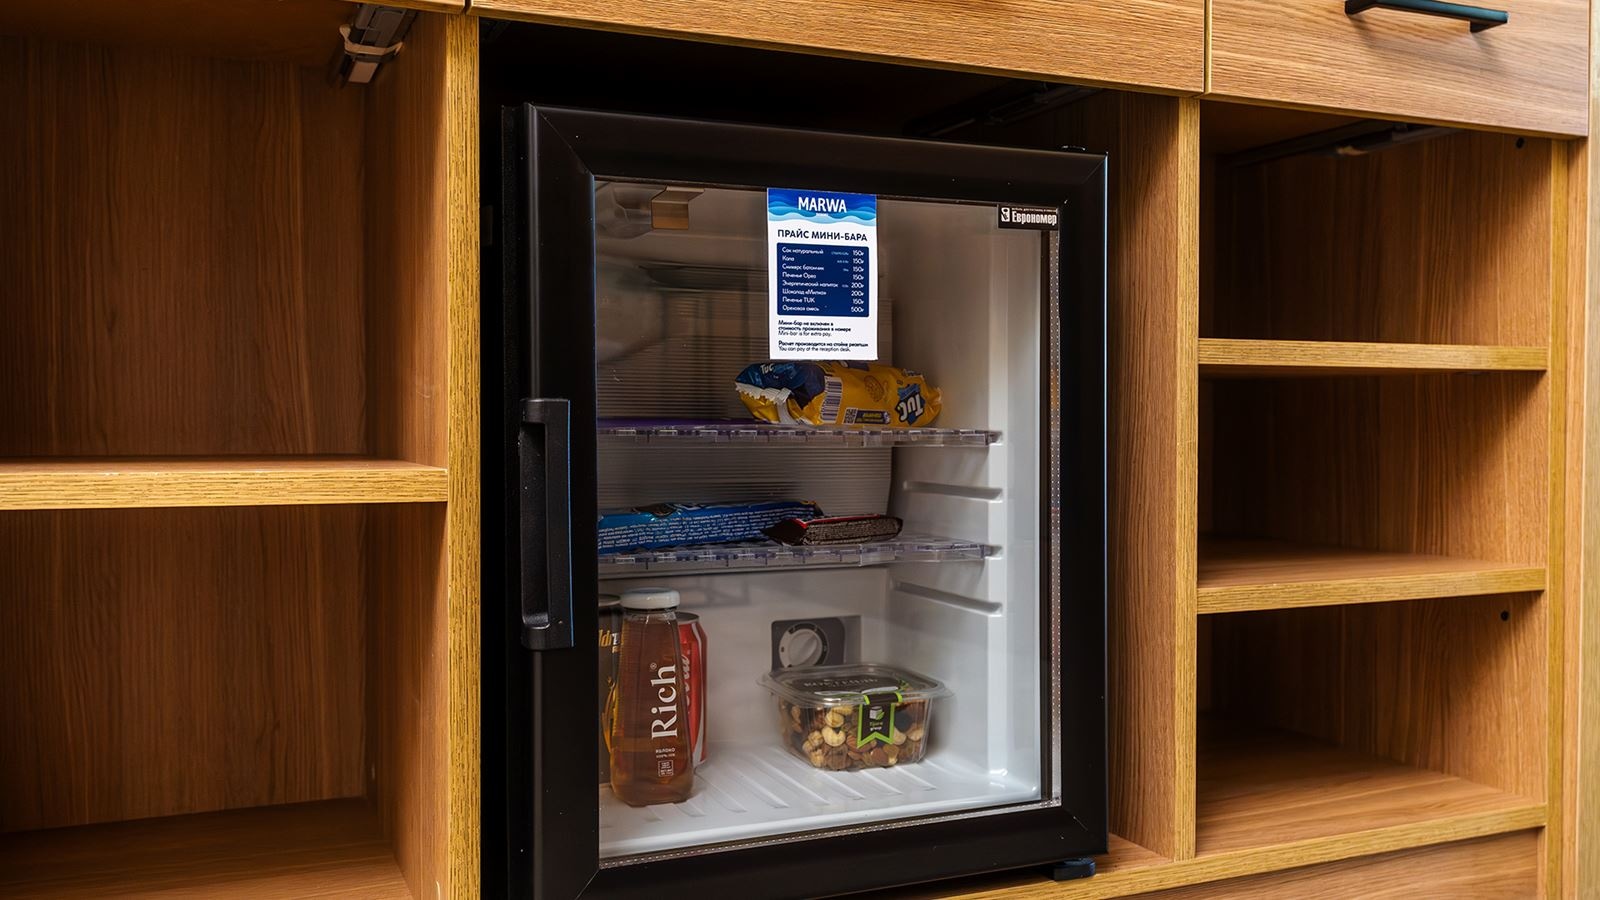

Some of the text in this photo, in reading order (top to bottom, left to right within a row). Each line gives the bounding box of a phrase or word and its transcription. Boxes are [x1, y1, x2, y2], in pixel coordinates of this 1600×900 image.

[798, 196, 847, 213] MARWA
[1012, 211, 1057, 226] Еврономер
[778, 228, 868, 241] ПРАЙС МИНИ-БАРА
[650, 664, 677, 740] Rich
